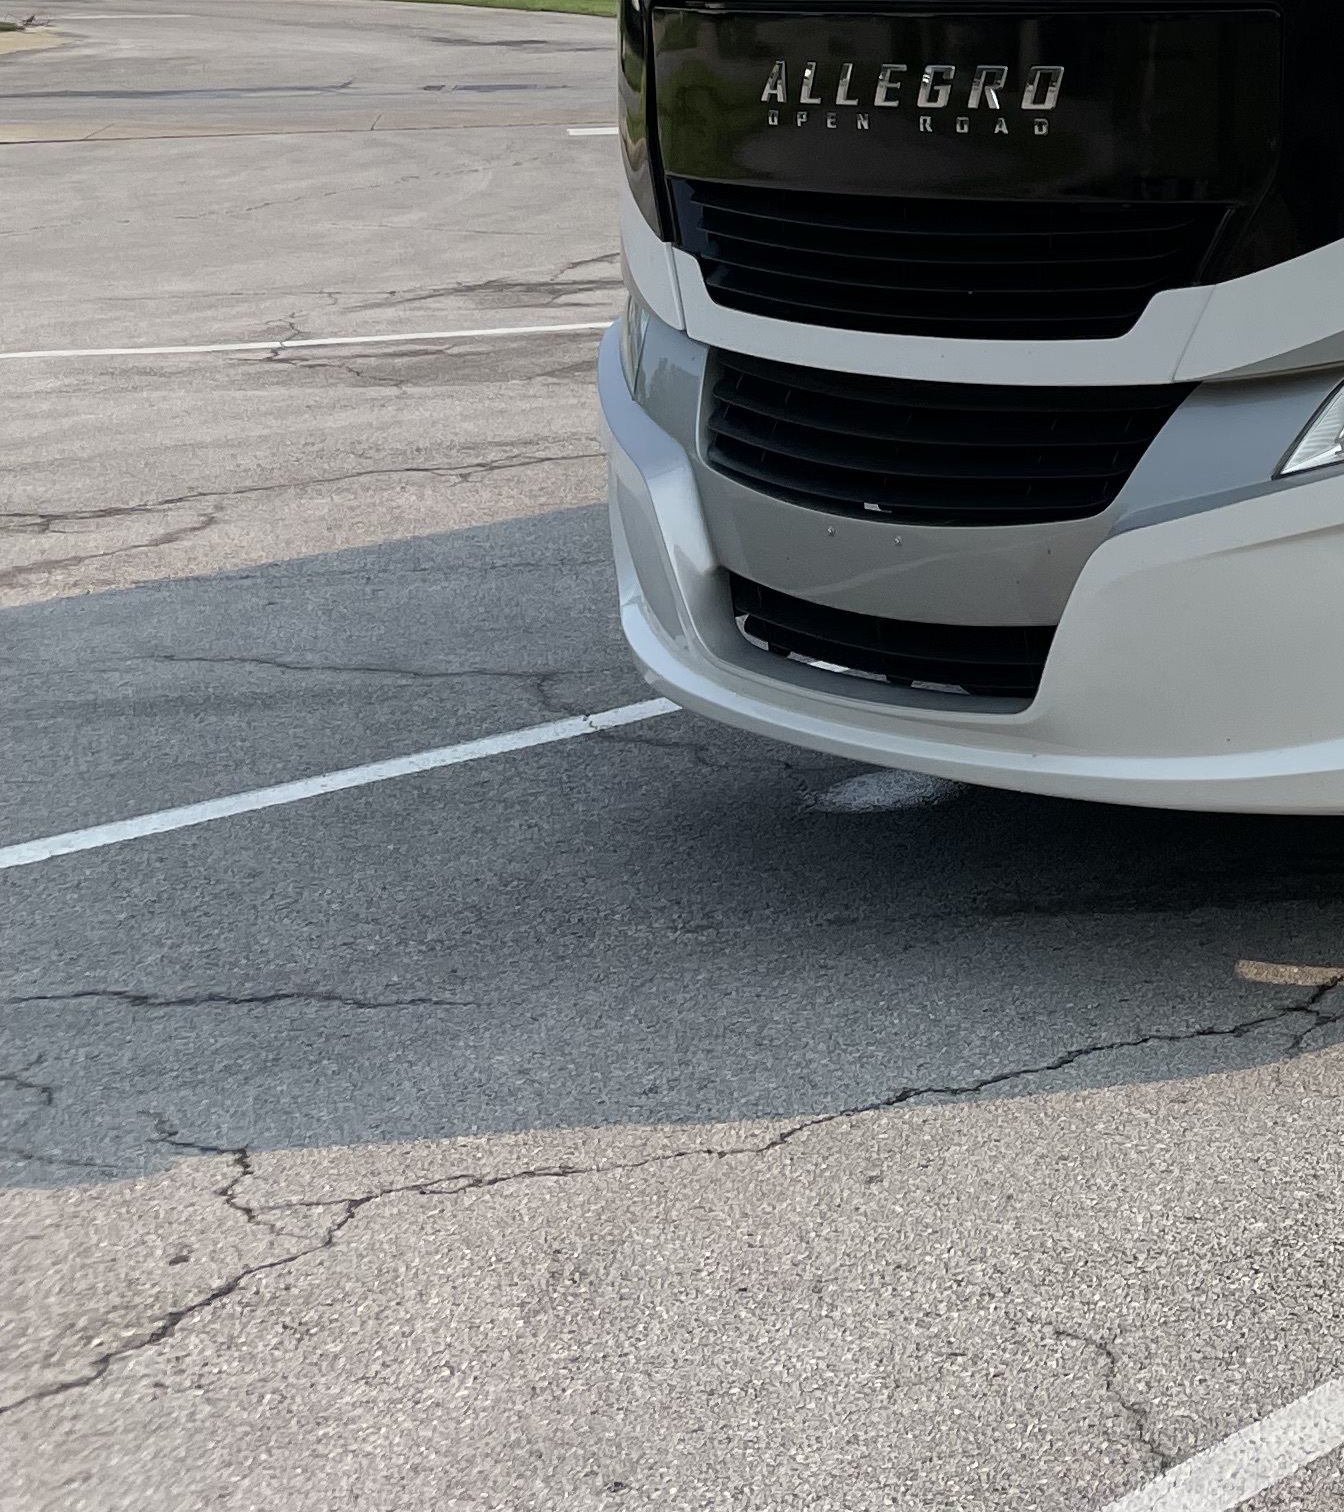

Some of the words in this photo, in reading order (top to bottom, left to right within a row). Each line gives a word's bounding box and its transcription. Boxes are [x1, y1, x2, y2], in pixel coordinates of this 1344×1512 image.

[761, 60, 1065, 110] ALLEGRO
[767, 109, 870, 131] OPEN
[919, 115, 1050, 136] ROAD
